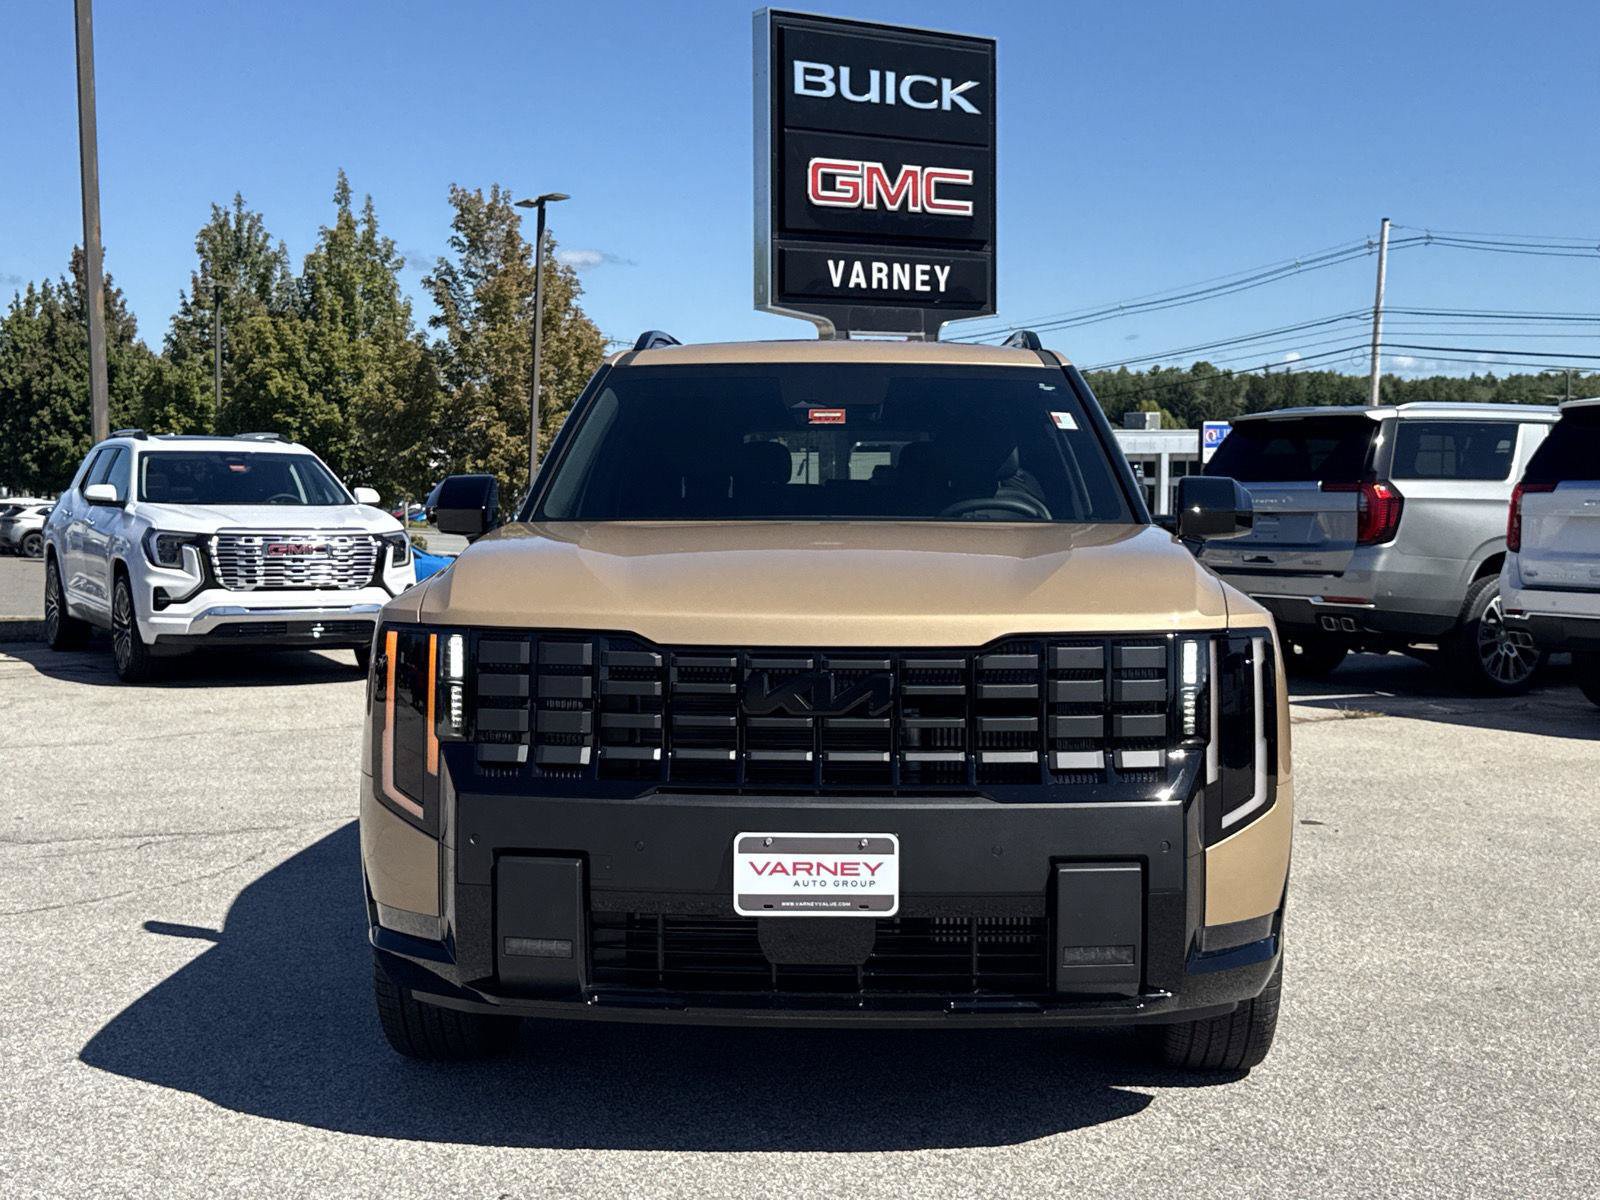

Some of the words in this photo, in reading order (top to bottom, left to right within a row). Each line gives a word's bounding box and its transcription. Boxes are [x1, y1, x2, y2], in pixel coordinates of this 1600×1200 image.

[793, 60, 982, 115] BUICK
[808, 157, 974, 216] GMC
[826, 259, 951, 292] VARNEY
[749, 861, 884, 876] VARNEY
